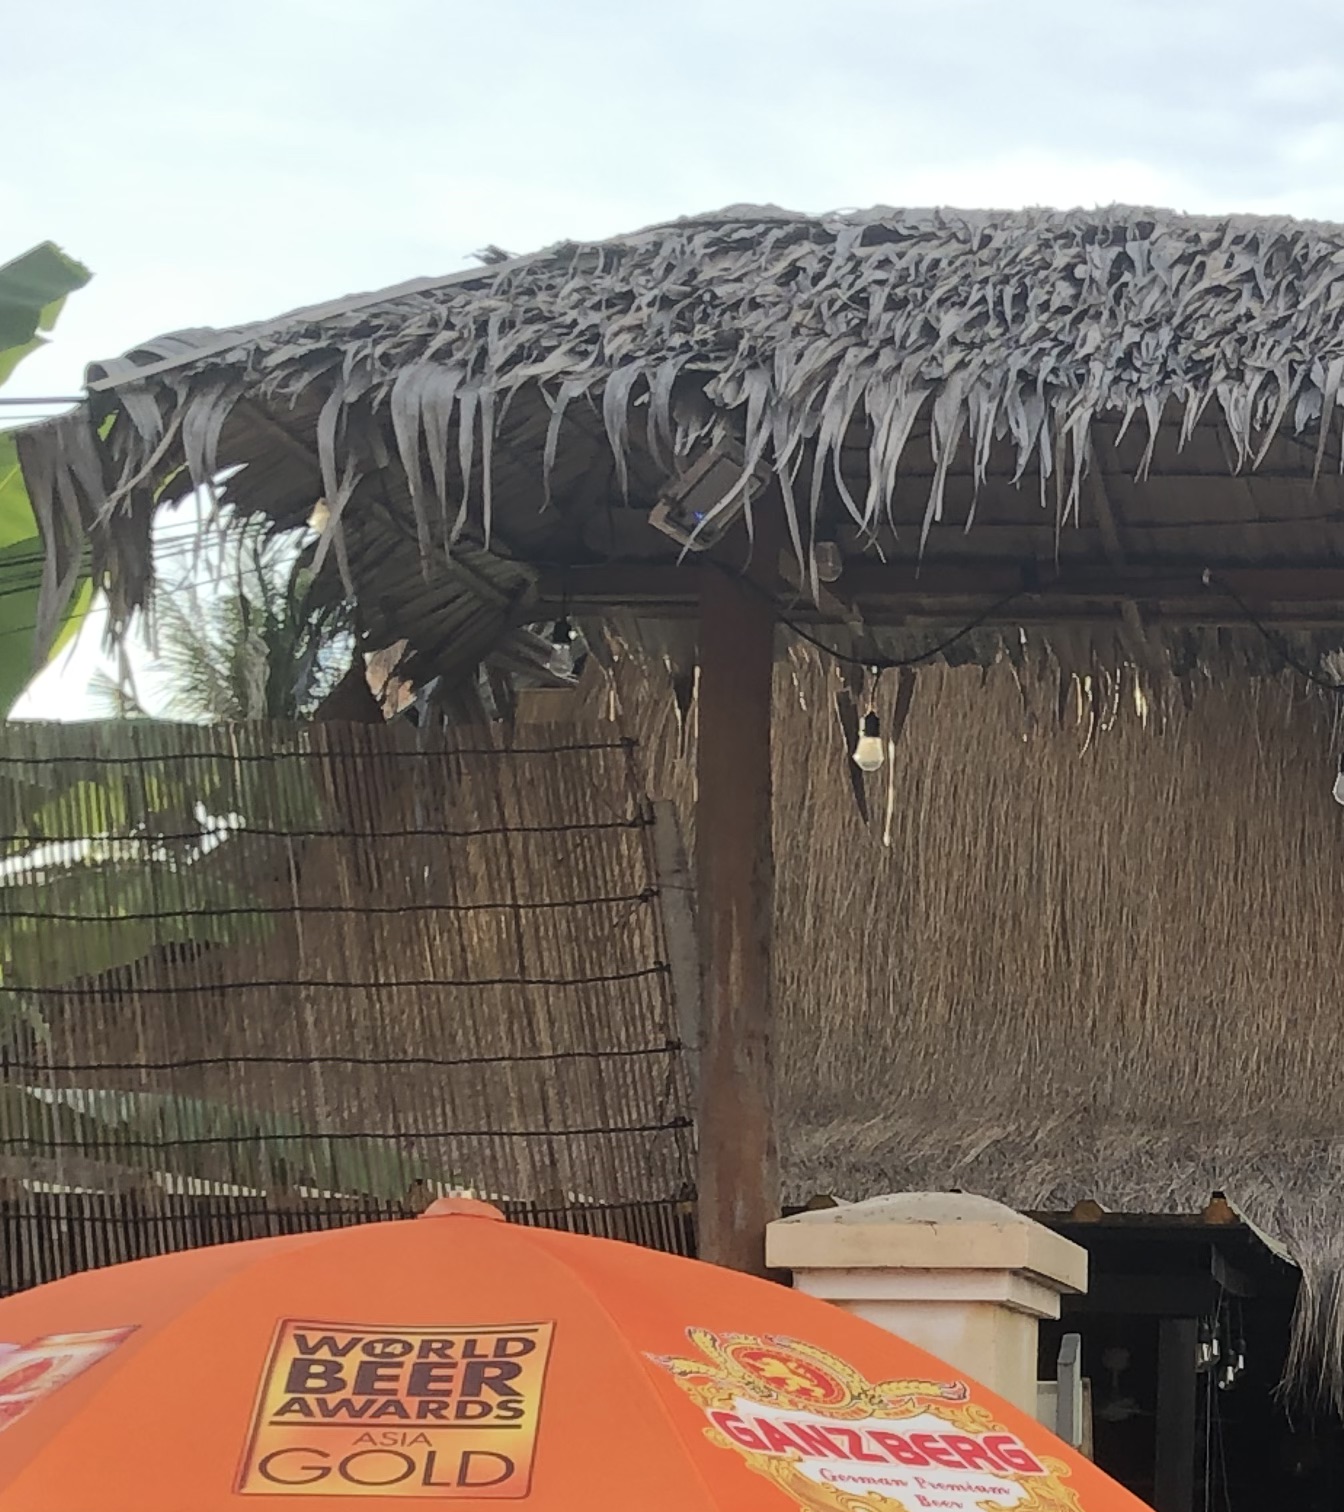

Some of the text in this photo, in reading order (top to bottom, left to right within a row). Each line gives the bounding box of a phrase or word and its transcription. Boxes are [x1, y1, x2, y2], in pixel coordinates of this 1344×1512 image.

[293, 1333, 536, 1360] WORLD
[284, 1357, 525, 1398] BEER
[273, 1396, 525, 1421] AWARDS
[352, 1431, 432, 1448] ASIA
[709, 1409, 1044, 1474] GANZBERG
[258, 1447, 515, 1488] GOLD
[819, 1467, 1011, 1495] German Premium
[915, 1494, 964, 1510] Beer
